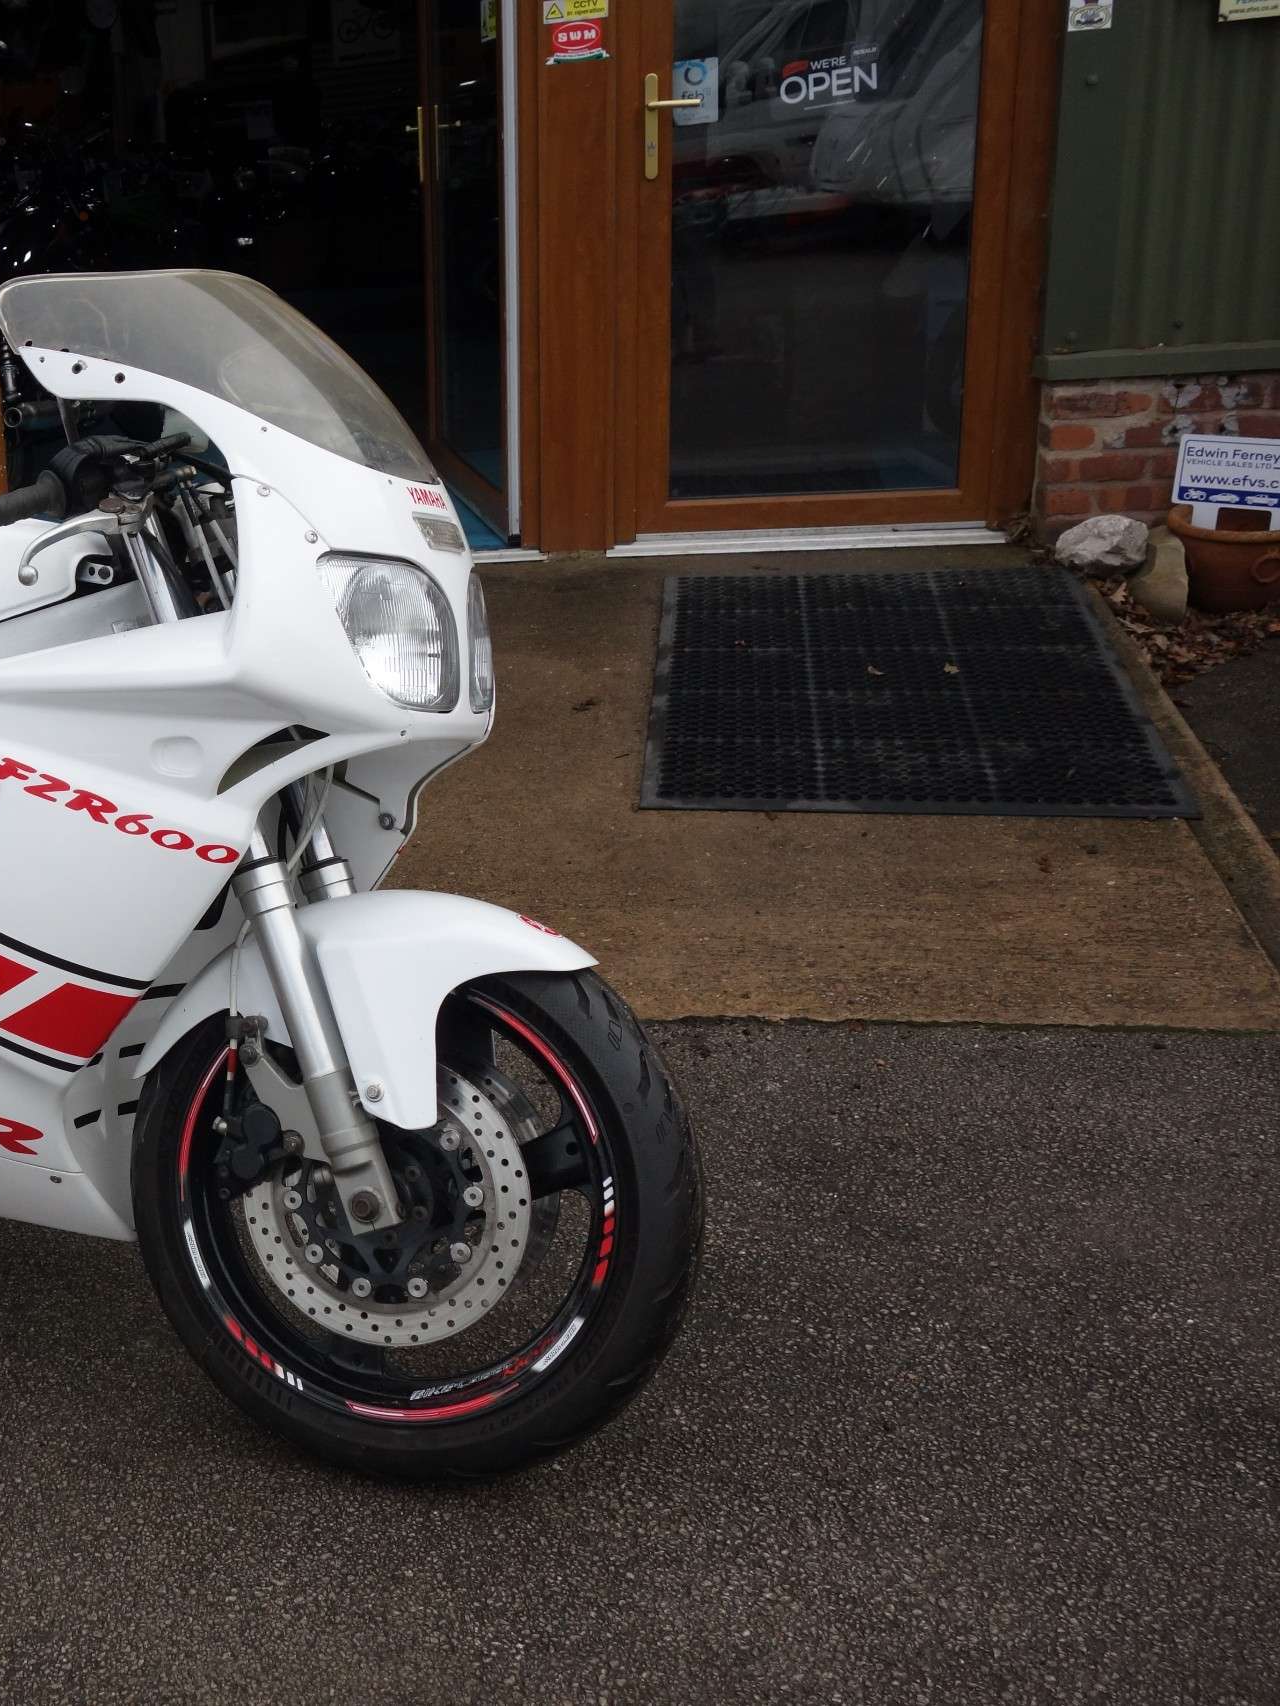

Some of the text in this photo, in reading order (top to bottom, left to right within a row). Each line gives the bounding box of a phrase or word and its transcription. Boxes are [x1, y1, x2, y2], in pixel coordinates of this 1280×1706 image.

[810, 56, 847, 70] WE'RE
[779, 62, 878, 105] OPEN
[1186, 446, 1229, 458] Edwin
[1186, 458, 1272, 470] VEHICLE SALES LTD
[1190, 475, 1280, 489] www.efvs.c
[406, 486, 448, 511] YAMAHA
